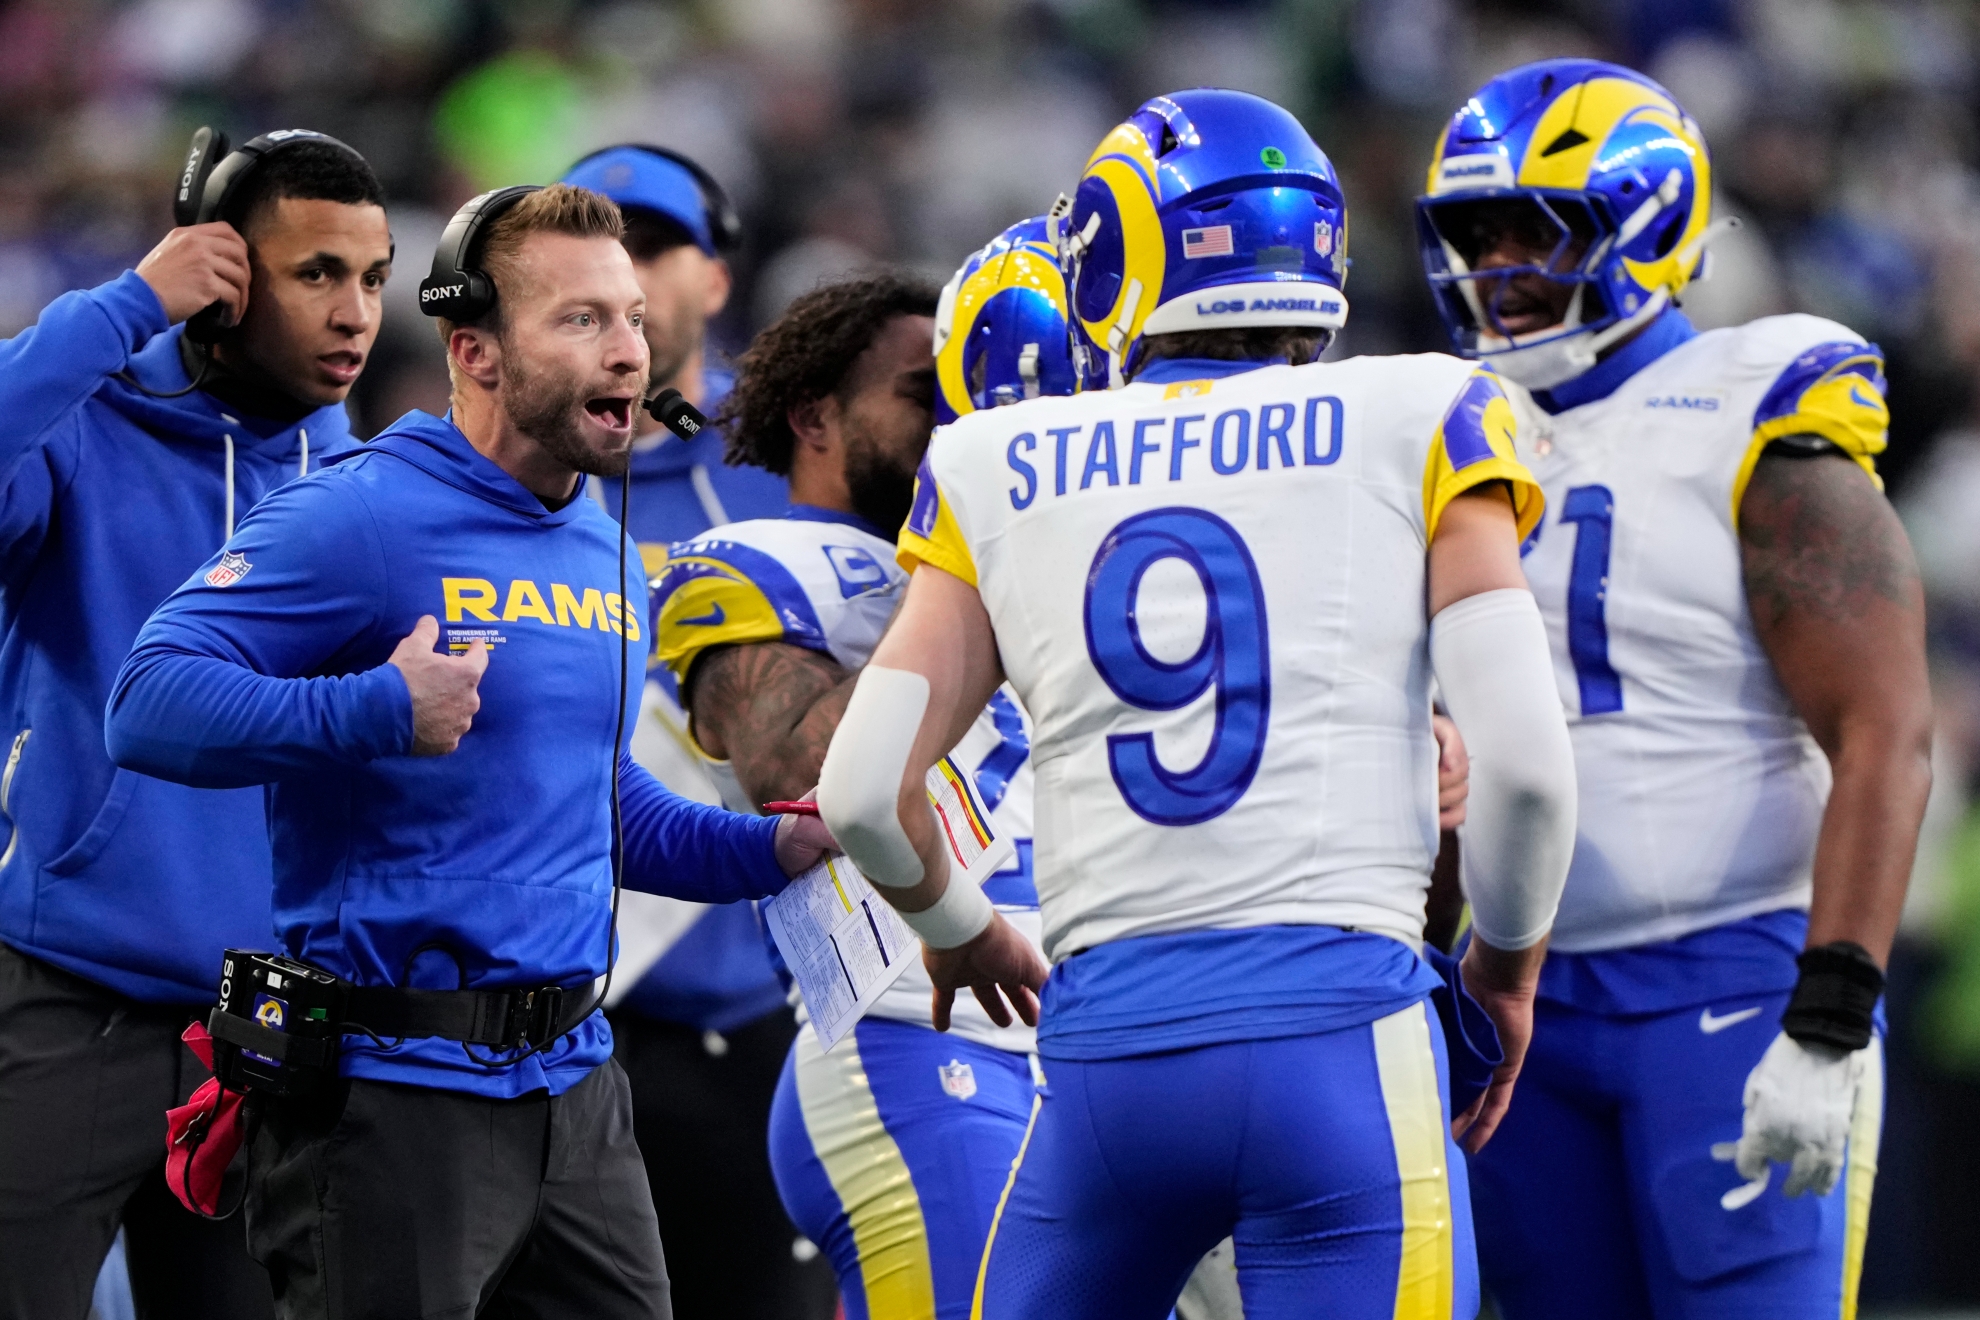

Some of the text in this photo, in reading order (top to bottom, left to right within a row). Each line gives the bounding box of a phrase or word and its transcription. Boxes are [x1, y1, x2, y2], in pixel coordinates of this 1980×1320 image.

[179, 147, 200, 201] SONY
[1444, 164, 1495, 179] RAMS
[421, 284, 464, 302] SONY
[1196, 298, 1341, 315] LOS ANGELES
[1645, 396, 1720, 411] RAMS
[1006, 395, 1344, 511] STAFFORD
[208, 566, 236, 585] NFL
[441, 577, 641, 642] RAMS
[1519, 484, 1624, 717] 1
[1083, 506, 1271, 827] 9
[219, 958, 234, 1012] SON
[255, 1004, 283, 1026] LA
